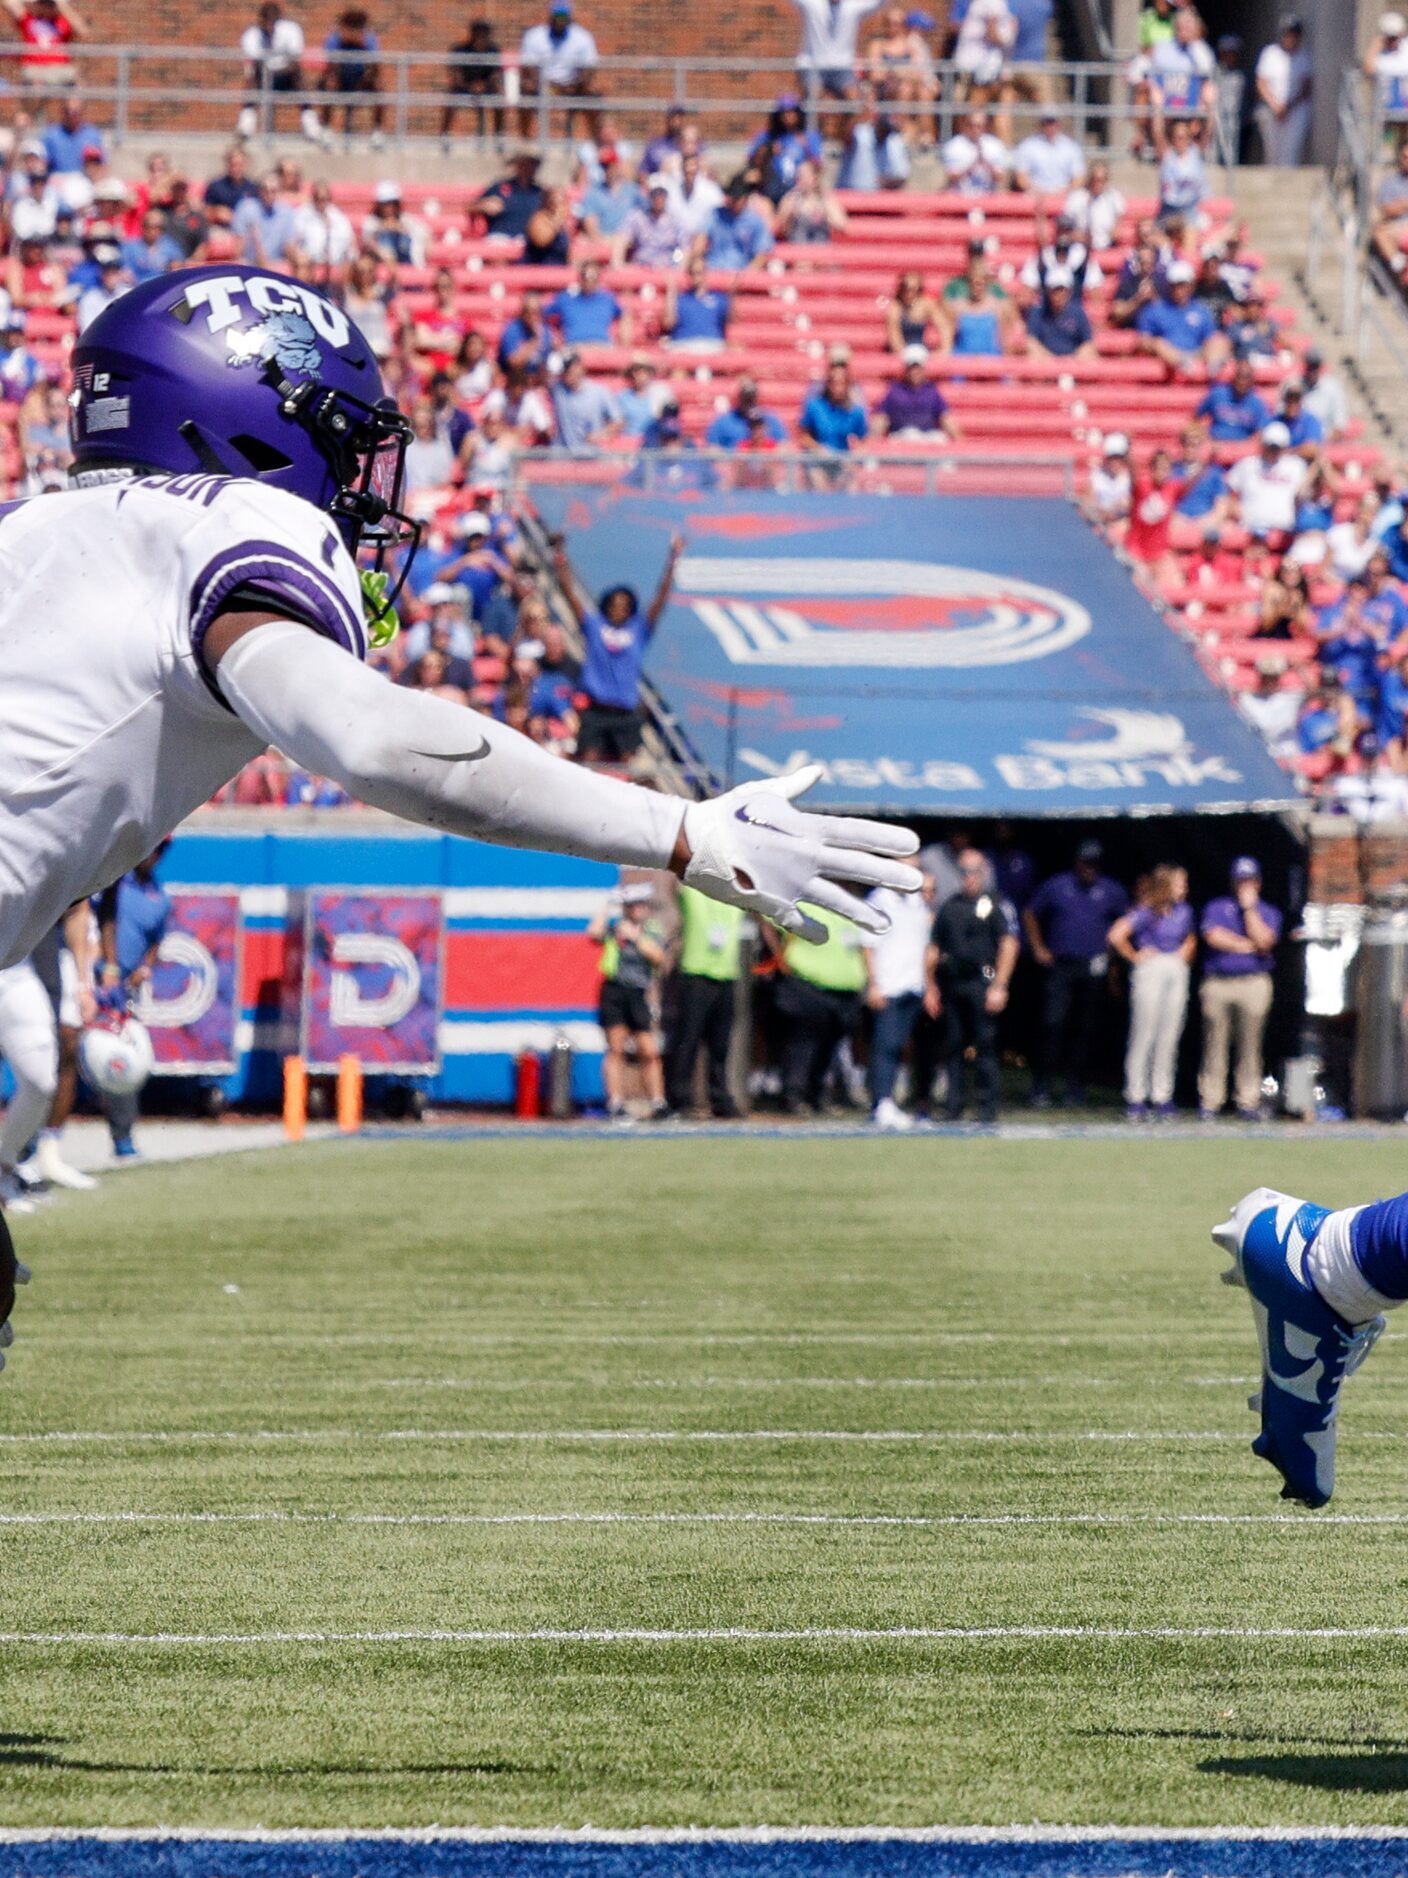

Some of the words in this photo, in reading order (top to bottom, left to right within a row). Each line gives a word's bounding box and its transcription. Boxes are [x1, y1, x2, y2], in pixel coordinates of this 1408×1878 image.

[185, 277, 350, 348] TCU
[93, 373, 110, 391] 12
[993, 752, 1244, 791] Bank
